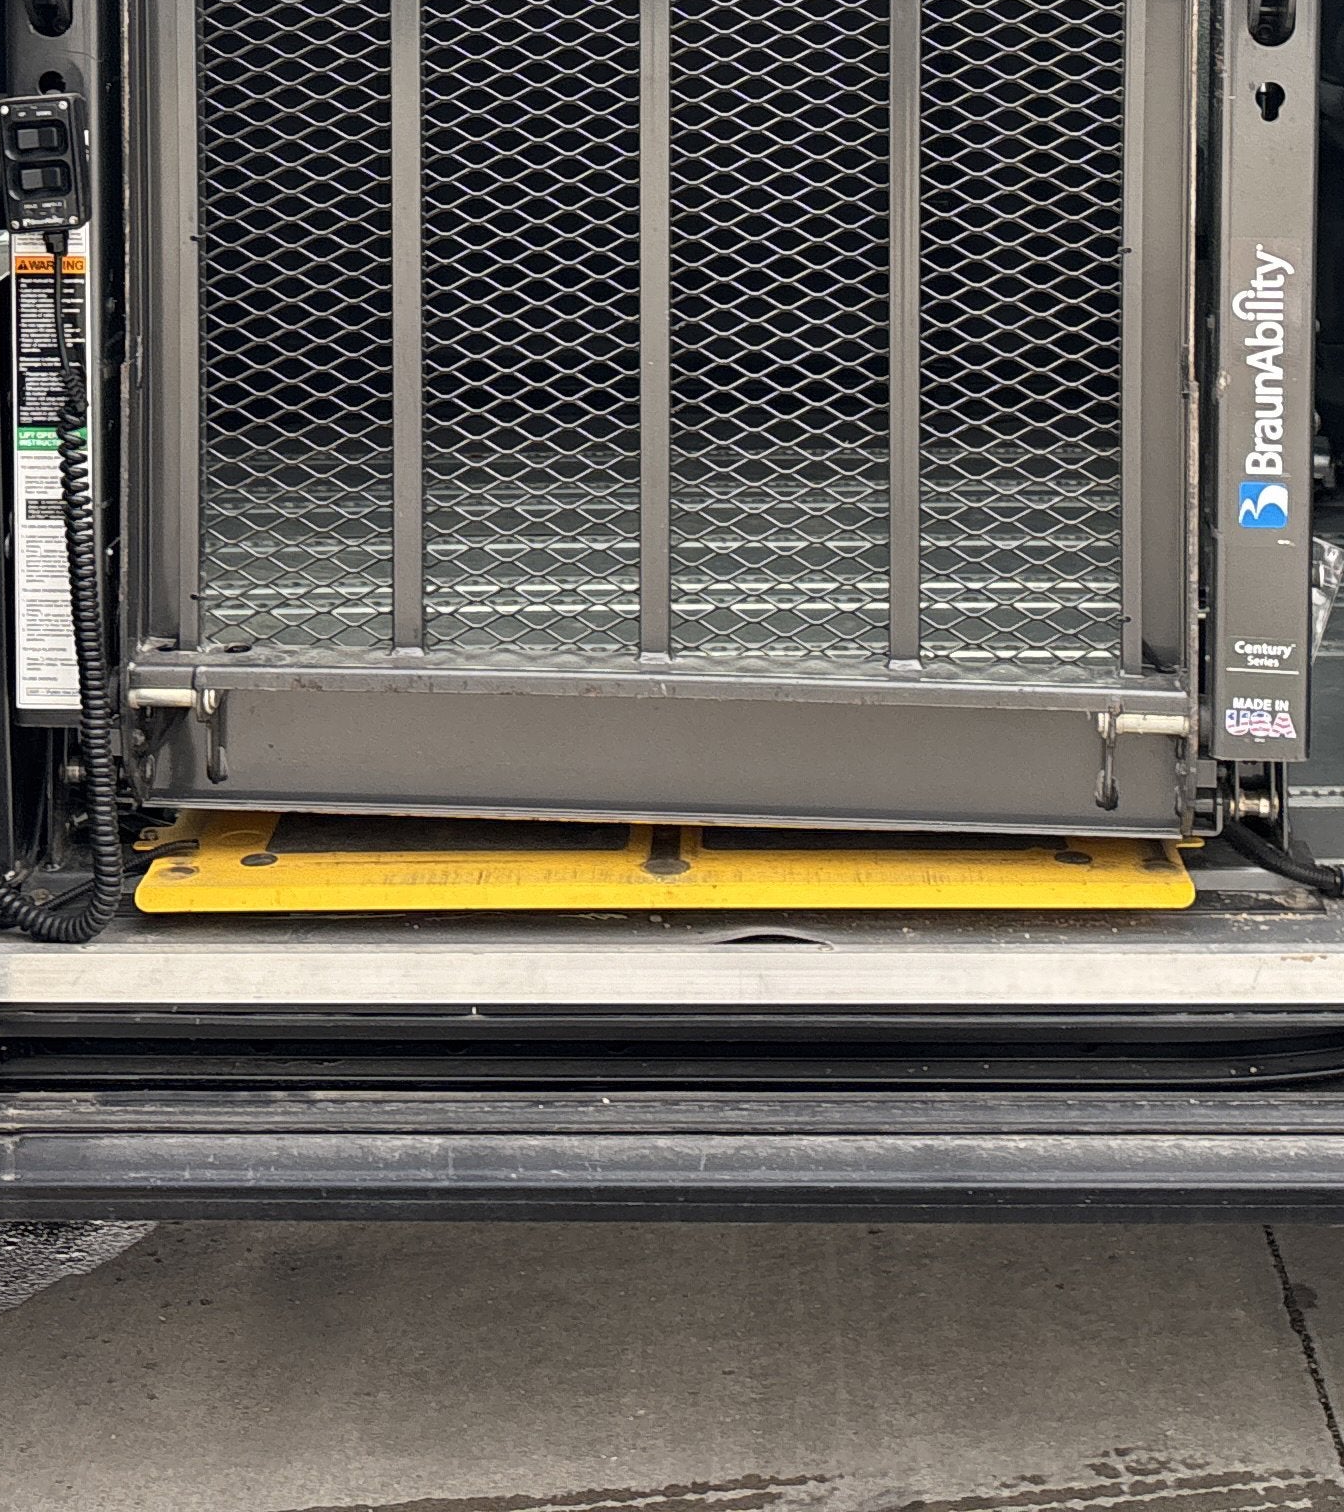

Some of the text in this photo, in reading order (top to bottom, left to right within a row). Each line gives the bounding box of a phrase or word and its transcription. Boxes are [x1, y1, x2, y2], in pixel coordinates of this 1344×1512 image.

[29, 260, 84, 271] WARING
[1231, 244, 1295, 476] BraunAbility
[1234, 640, 1293, 659] Century
[1246, 655, 1280, 668] Series
[1232, 697, 1290, 712] MADE IN
[1225, 709, 1297, 738] USA
